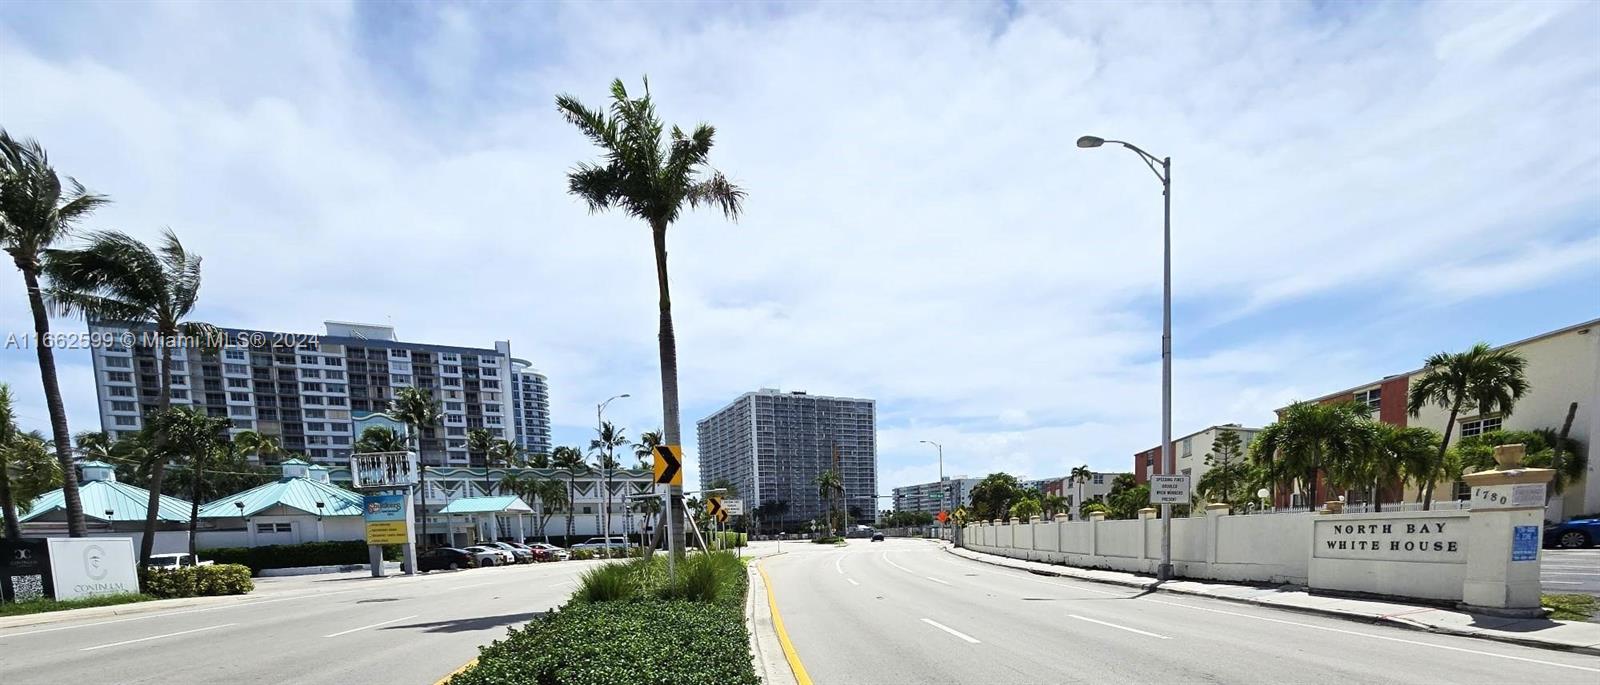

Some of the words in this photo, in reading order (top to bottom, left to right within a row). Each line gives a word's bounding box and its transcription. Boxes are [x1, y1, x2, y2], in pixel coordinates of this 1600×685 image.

[1475, 488, 1507, 505] 1780
[1334, 524, 1392, 535] NORTH
[1406, 522, 1446, 534] BAY
[1327, 541, 1380, 551] WHITE
[1390, 541, 1458, 552] HOUSE
